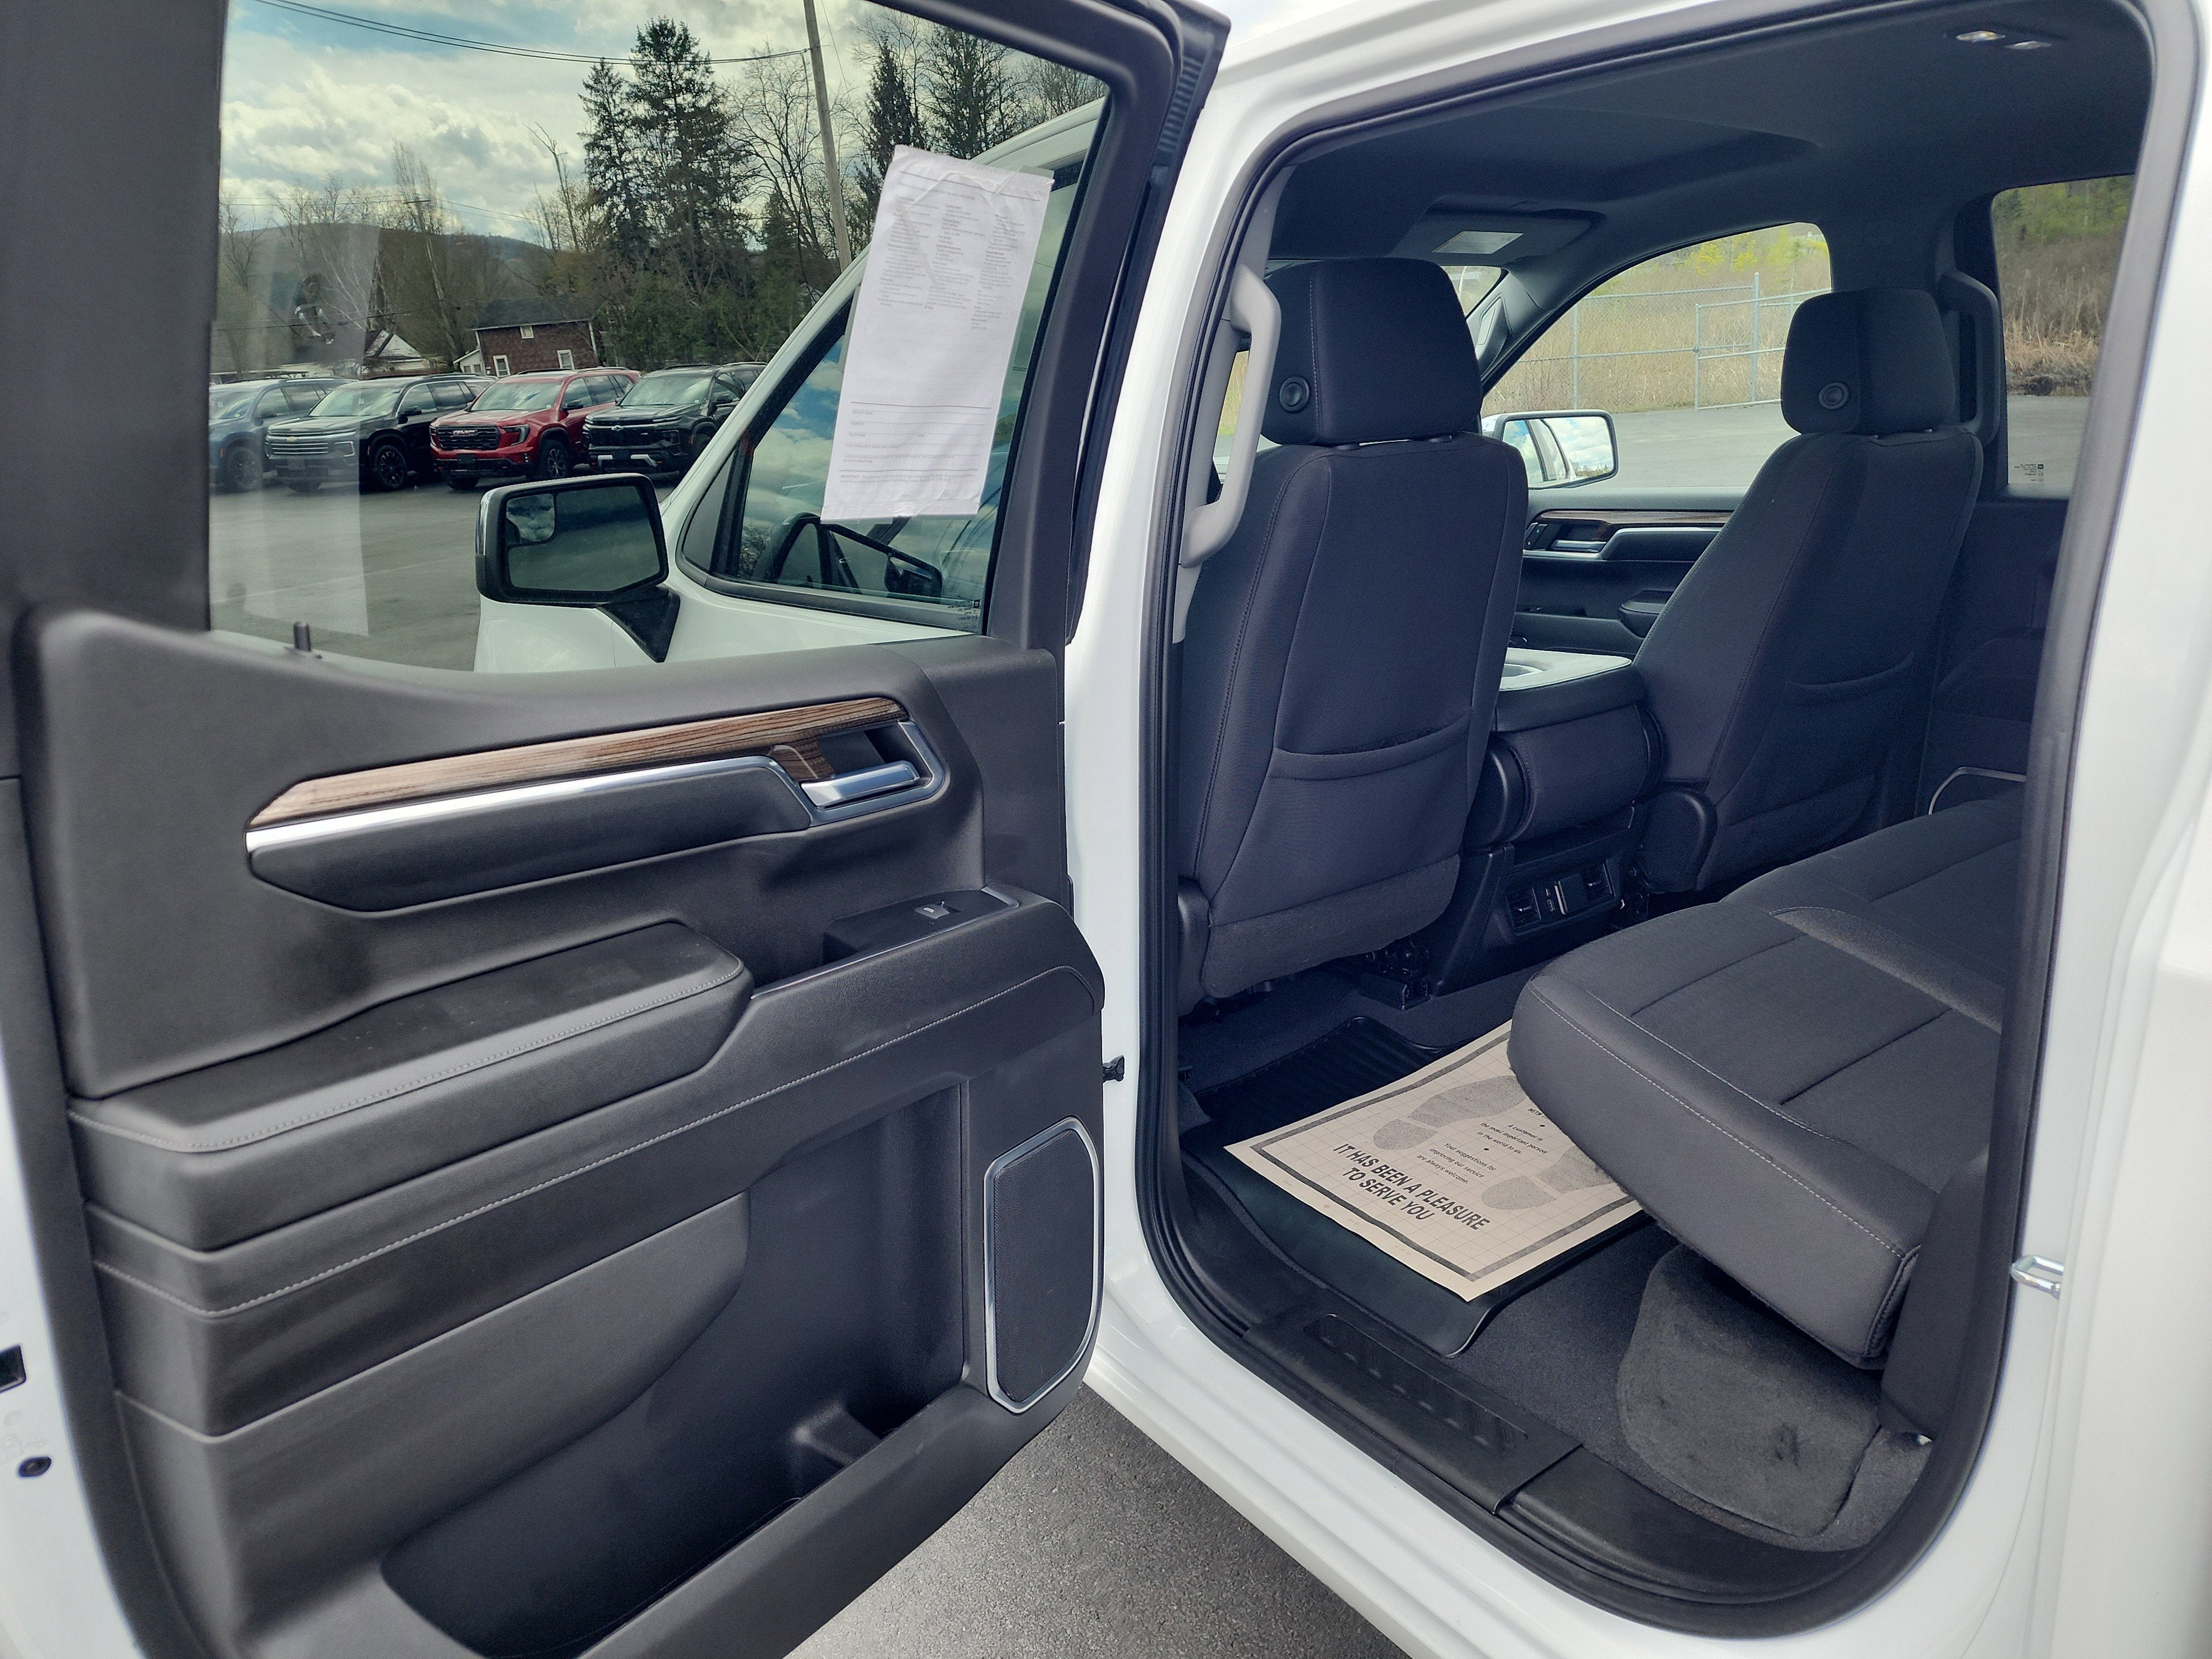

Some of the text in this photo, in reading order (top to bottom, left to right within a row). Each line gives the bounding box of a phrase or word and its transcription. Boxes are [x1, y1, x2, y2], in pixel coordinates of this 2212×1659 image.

[1493, 1139, 1509, 1147] world
[1503, 1132, 1528, 1146] important
[1527, 1144, 1547, 1154] person
[1512, 1126, 1537, 1139] customer
[1429, 1148, 1455, 1163] improving
[1463, 1166, 1484, 1178] service
[1444, 1142, 1457, 1151] Your
[1455, 1150, 1488, 1167] suggestions
[1426, 1159, 1445, 1171] always
[1444, 1169, 1469, 1184] welcome.
[1333, 1144, 1490, 1230] IT HAS BEEN A PLEASURE
[1342, 1167, 1435, 1220] TO SERVE YOU
